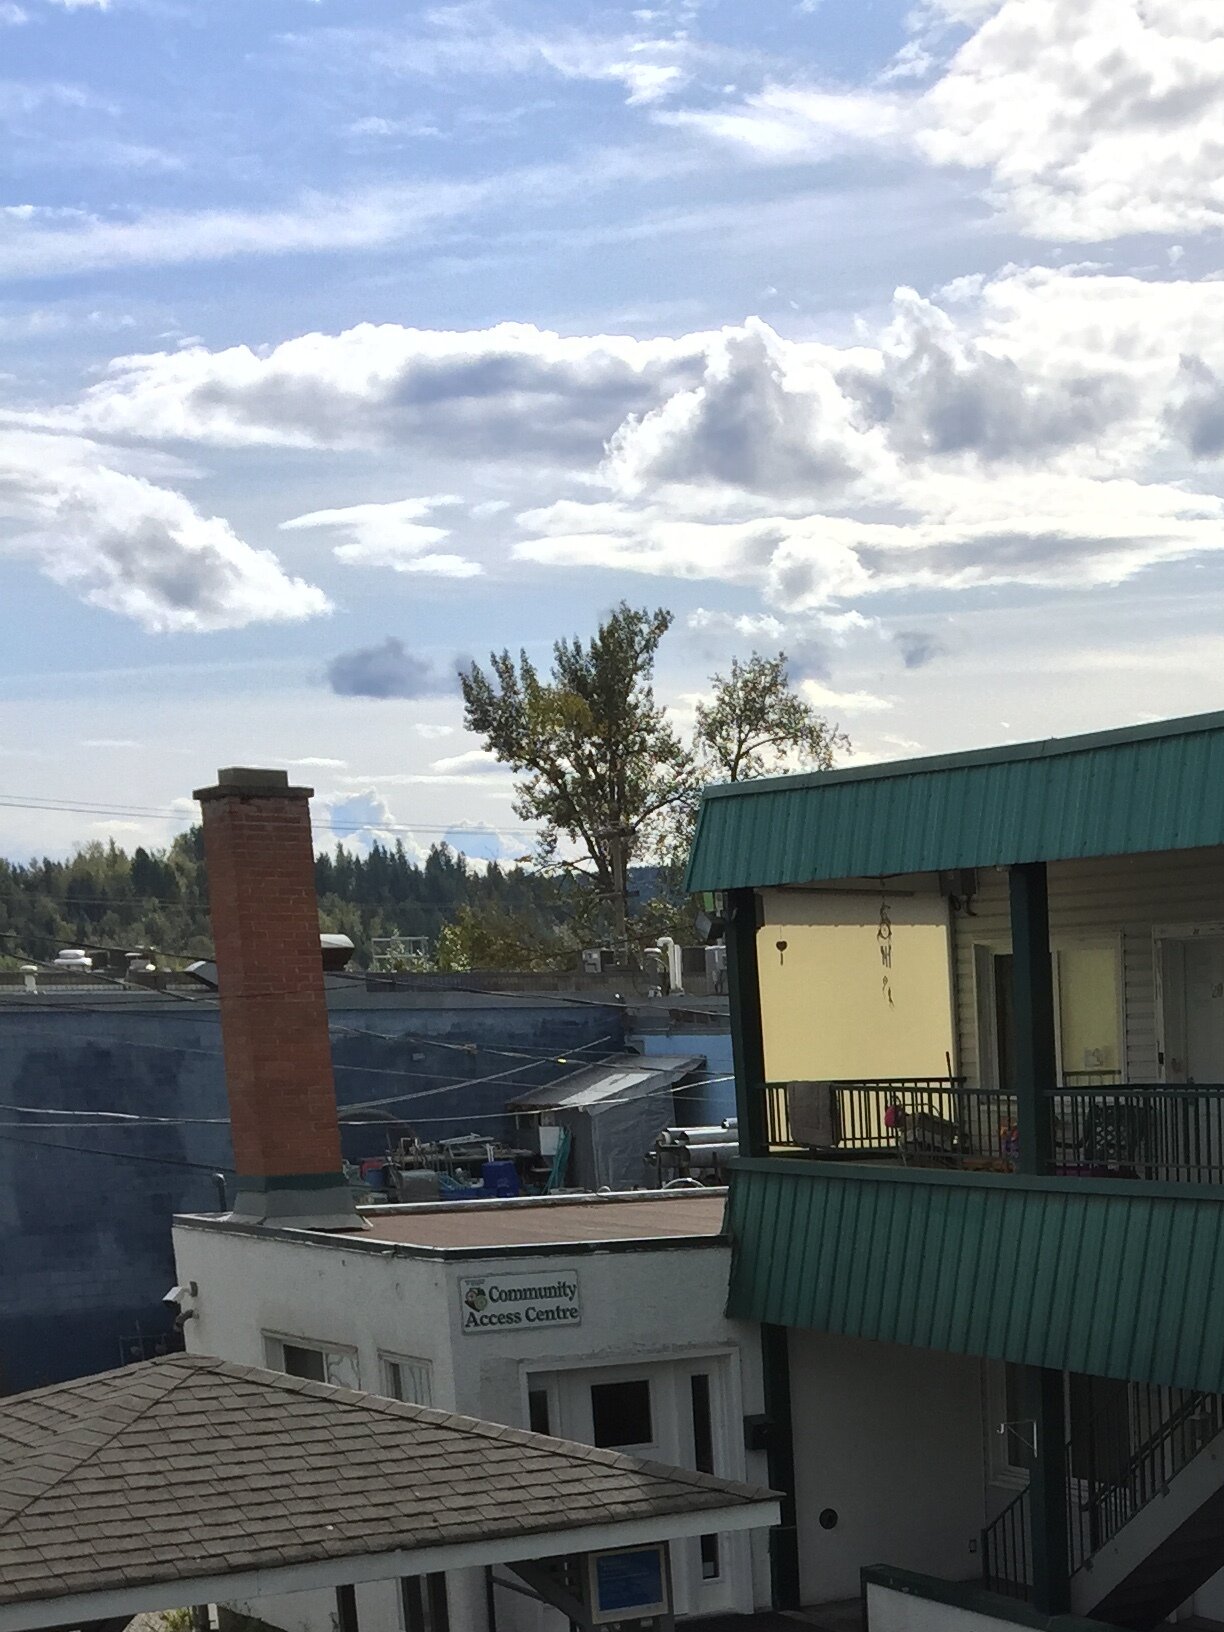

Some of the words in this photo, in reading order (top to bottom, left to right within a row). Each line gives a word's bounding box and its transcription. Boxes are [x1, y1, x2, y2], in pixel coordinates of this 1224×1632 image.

[489, 1281, 577, 1302] Community
[466, 1311, 522, 1328] Access
[525, 1305, 578, 1323] Centre
